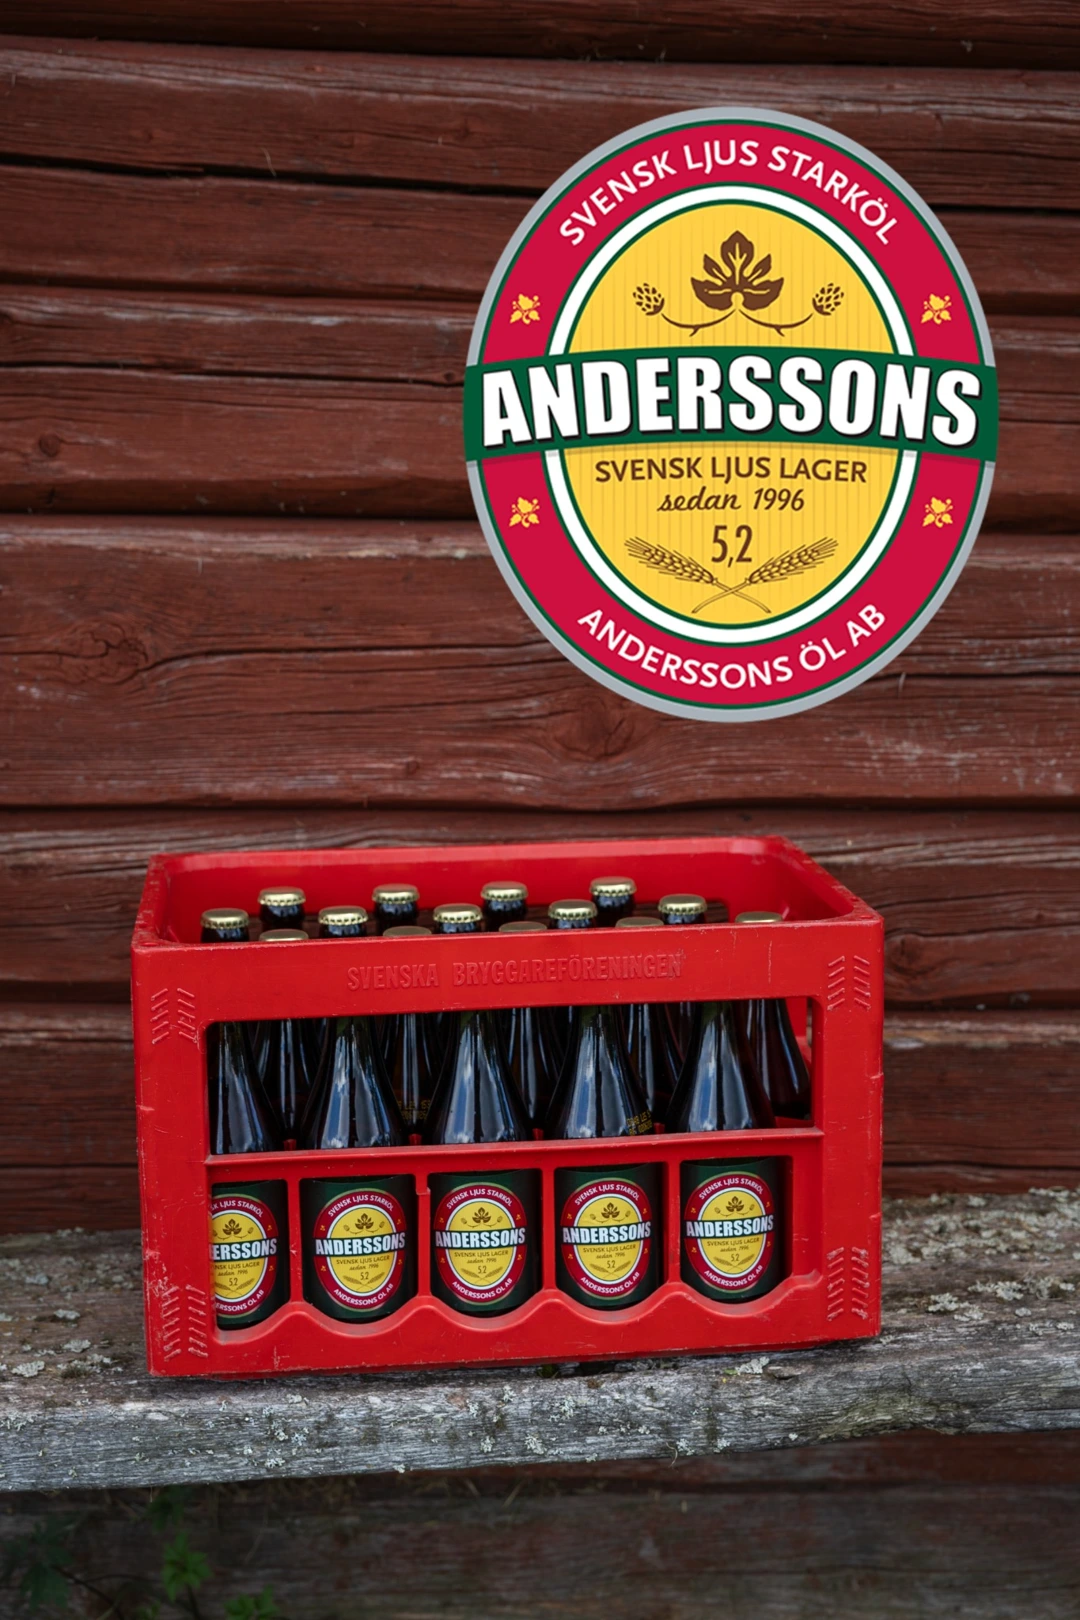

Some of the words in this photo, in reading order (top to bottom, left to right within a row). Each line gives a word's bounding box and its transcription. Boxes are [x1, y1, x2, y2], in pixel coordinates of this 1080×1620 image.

[348, 962, 439, 992] SVENSKA
[453, 953, 683, 988] BRYGGAREFÖRENINGEN
[446, 1191, 468, 1210] SVENSK
[469, 1188, 486, 1197] LJUS
[574, 1187, 598, 1206] SVENSK
[598, 1184, 615, 1193] LJUS
[698, 1181, 723, 1200] SVENSK
[723, 1177, 739, 1186] LJUS
[220, 1200, 236, 1210] LJUS
[328, 1196, 352, 1217] SVENSK
[352, 1194, 369, 1203] LJUS
[562, 1221, 651, 1244] ANDERSSONS
[686, 1214, 774, 1237] ANDERSSONS
[315, 1232, 406, 1255] ANDERSSONS
[435, 1227, 526, 1248] ANDERSSONS
[580, 1276, 624, 1294] ANDERSSONS
[704, 1270, 748, 1287] ANDERSSONS
[334, 1288, 378, 1306] ANDERSSONS
[452, 1281, 496, 1299] ANDERSSONS
